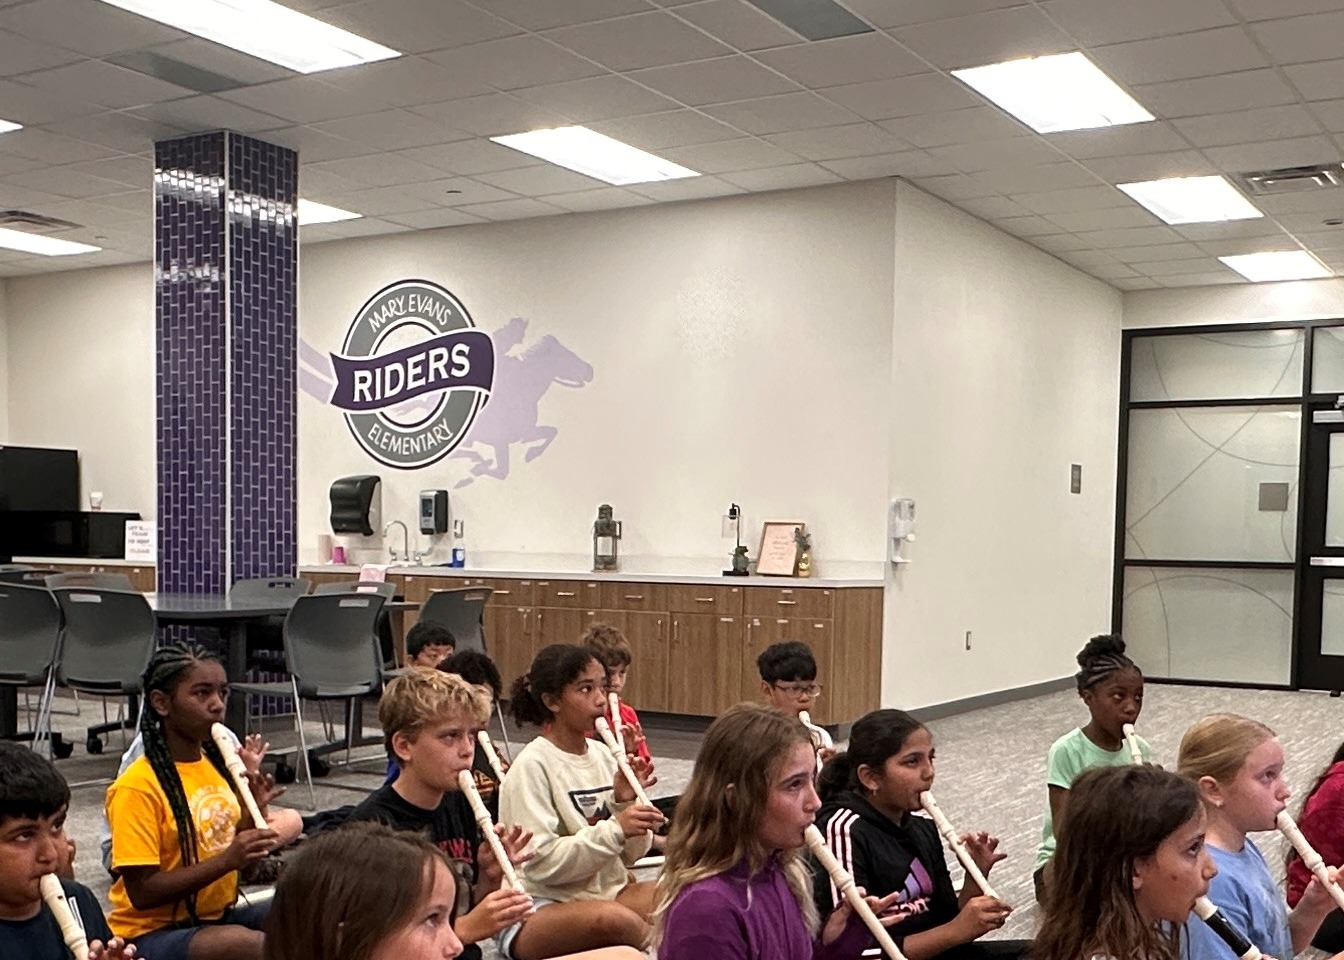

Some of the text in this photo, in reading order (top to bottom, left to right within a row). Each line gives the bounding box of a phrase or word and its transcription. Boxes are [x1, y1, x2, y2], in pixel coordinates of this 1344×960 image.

[368, 293, 452, 333] MARY EVANS
[353, 343, 470, 402] RIDERS
[367, 418, 454, 455] ELEMENTARY
